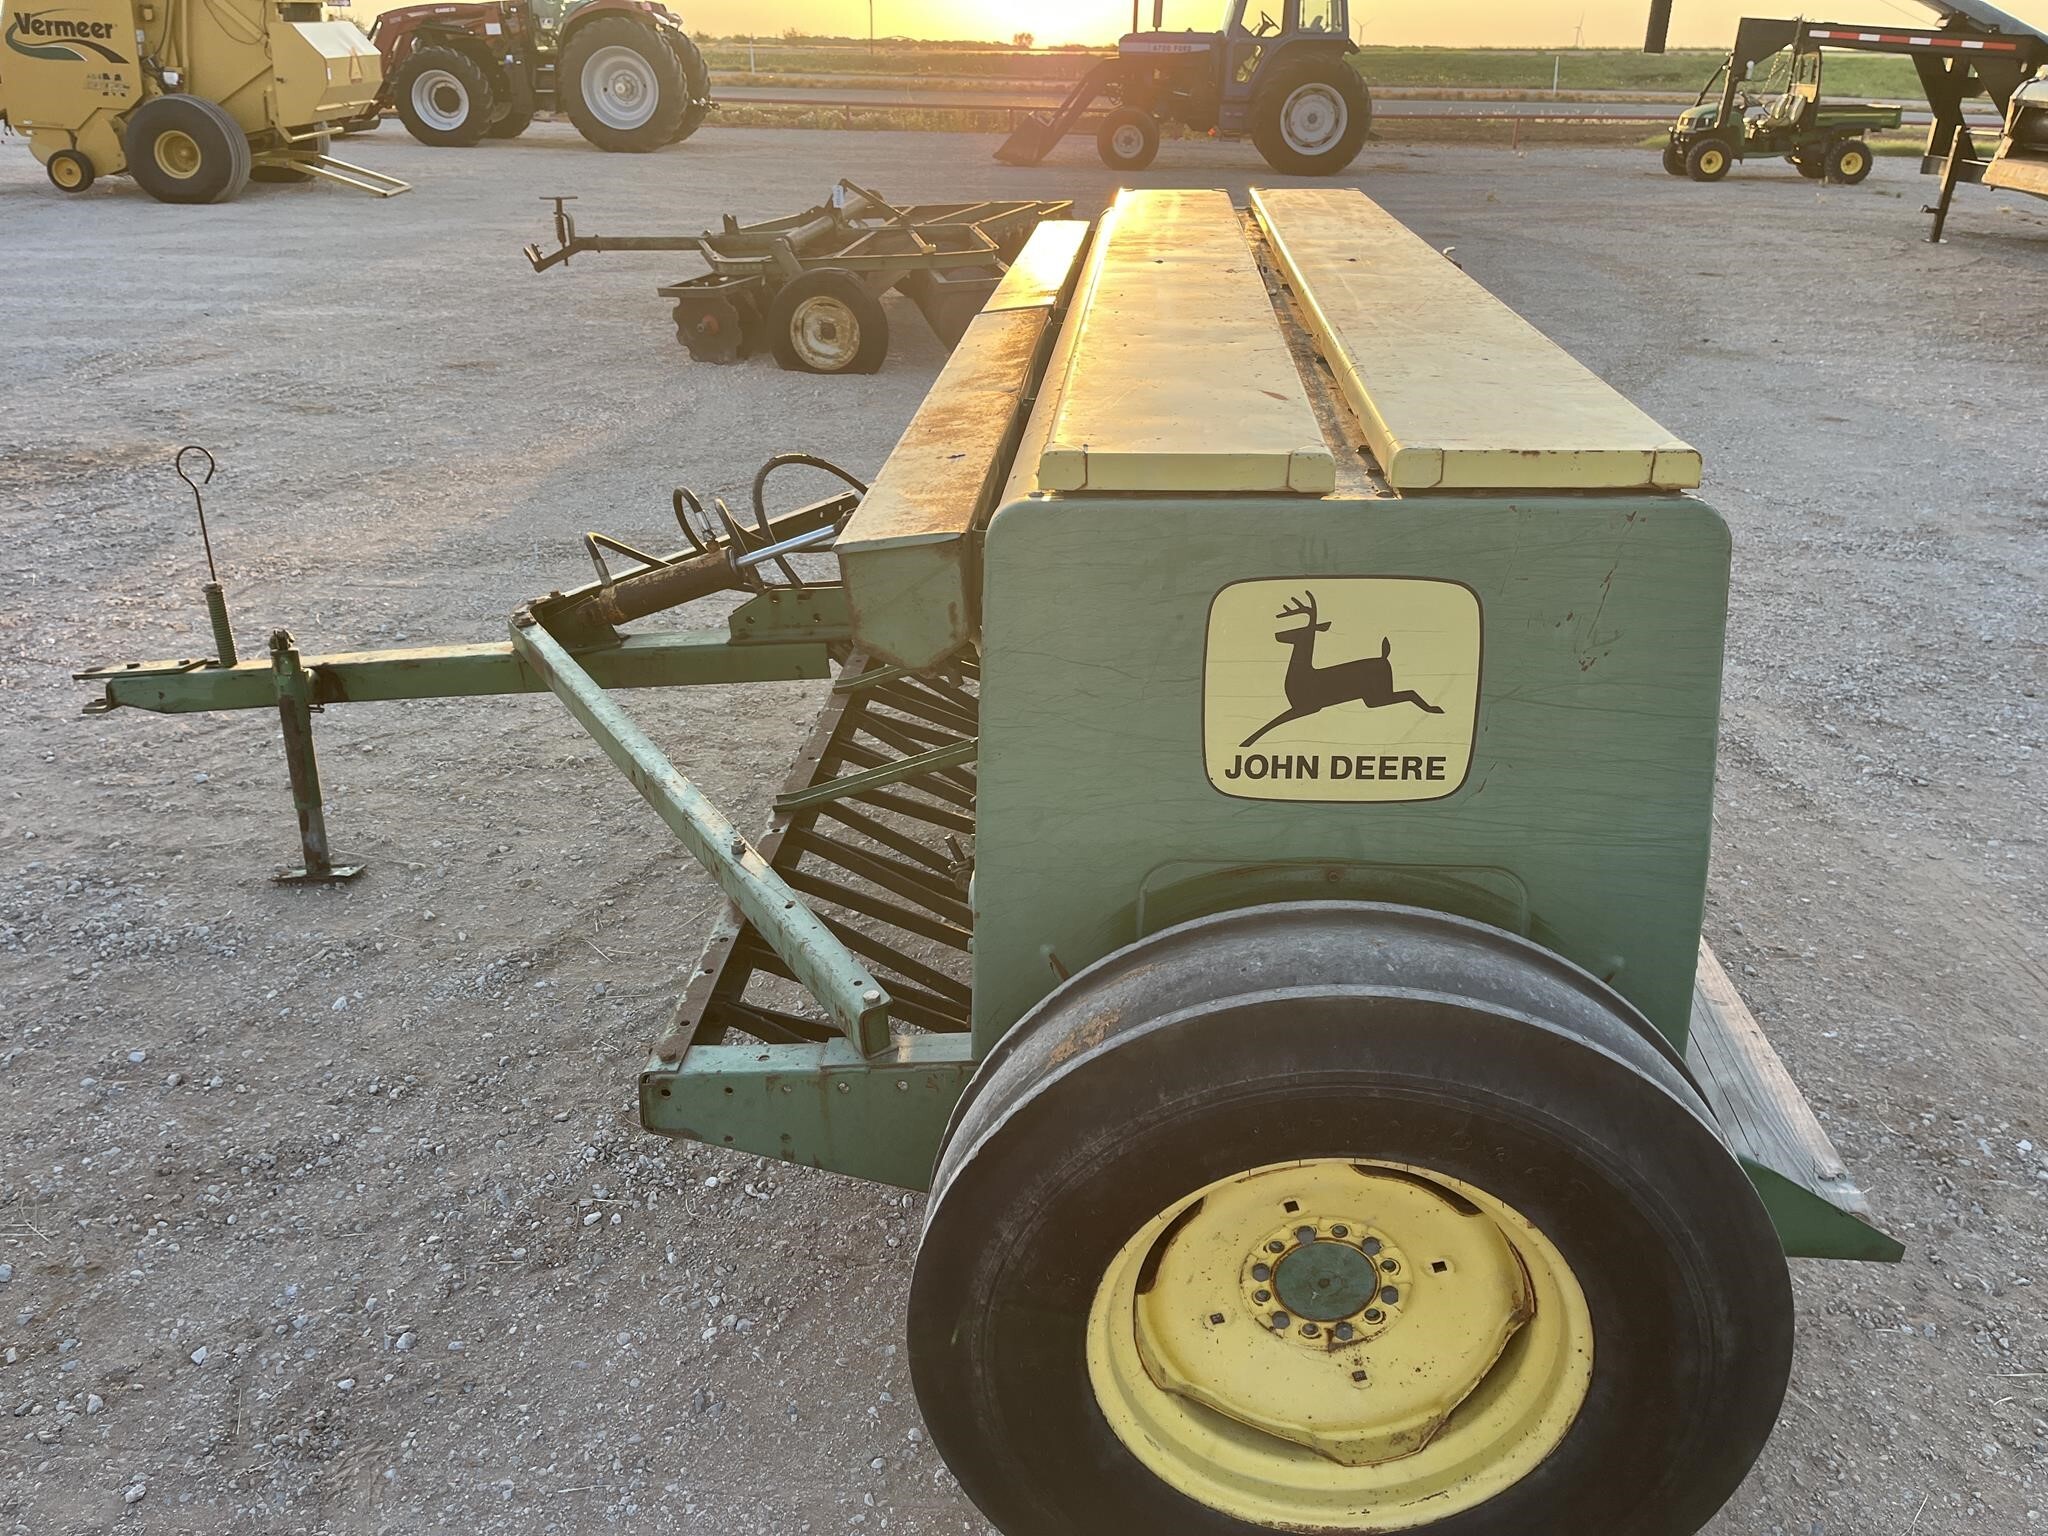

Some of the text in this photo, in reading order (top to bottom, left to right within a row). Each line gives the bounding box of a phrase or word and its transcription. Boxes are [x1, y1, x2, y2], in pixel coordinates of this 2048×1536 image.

[14, 12, 113, 39] Vermeer
[1225, 754, 1447, 781] JOHN DEERE
